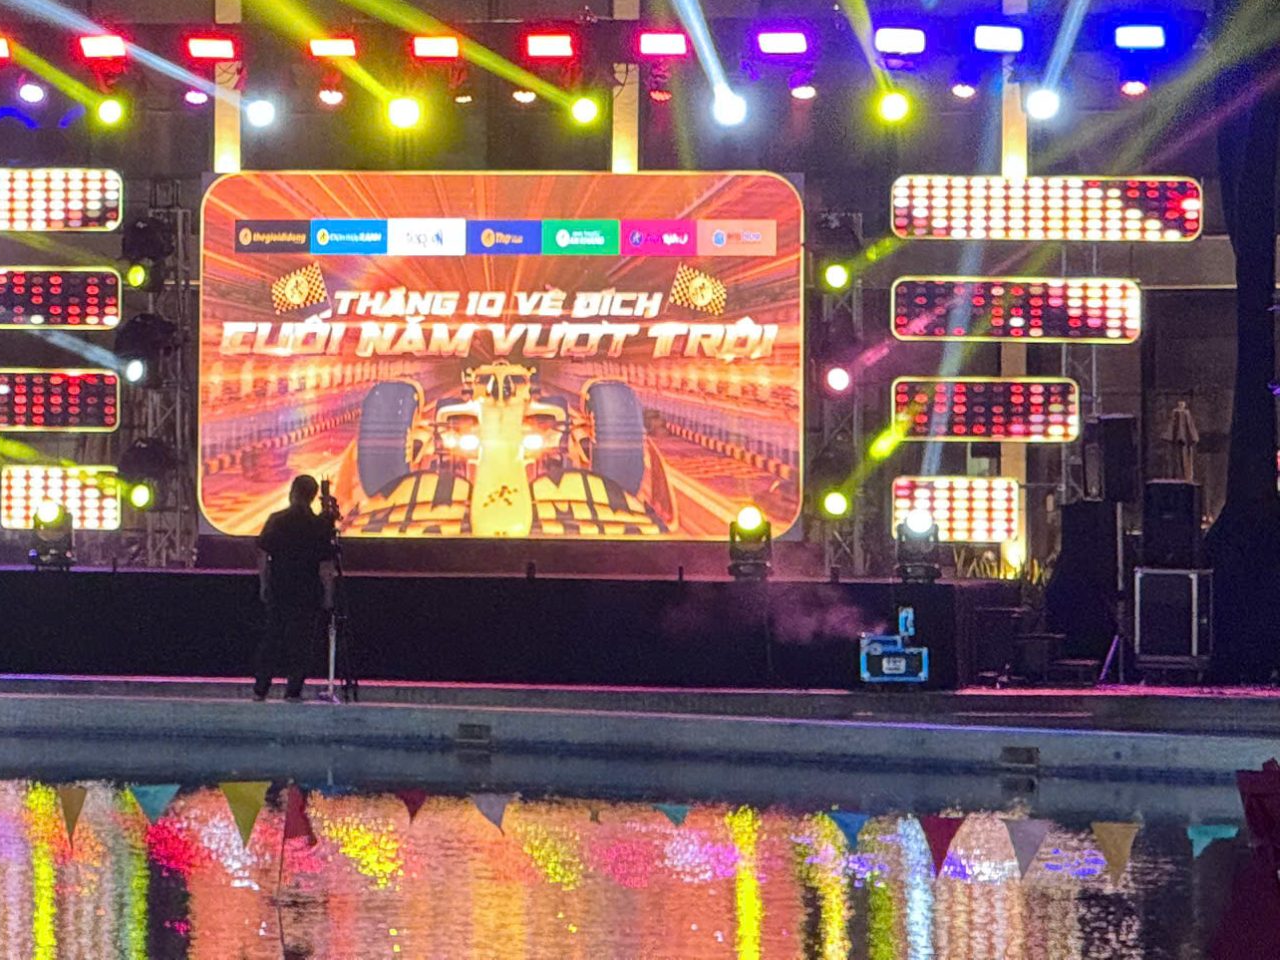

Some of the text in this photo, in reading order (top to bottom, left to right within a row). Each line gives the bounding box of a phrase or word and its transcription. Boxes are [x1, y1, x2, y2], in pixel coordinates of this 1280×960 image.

[333, 286, 460, 317] THÁNG
[465, 291, 508, 317] 10
[354, 316, 477, 358] NĂM
